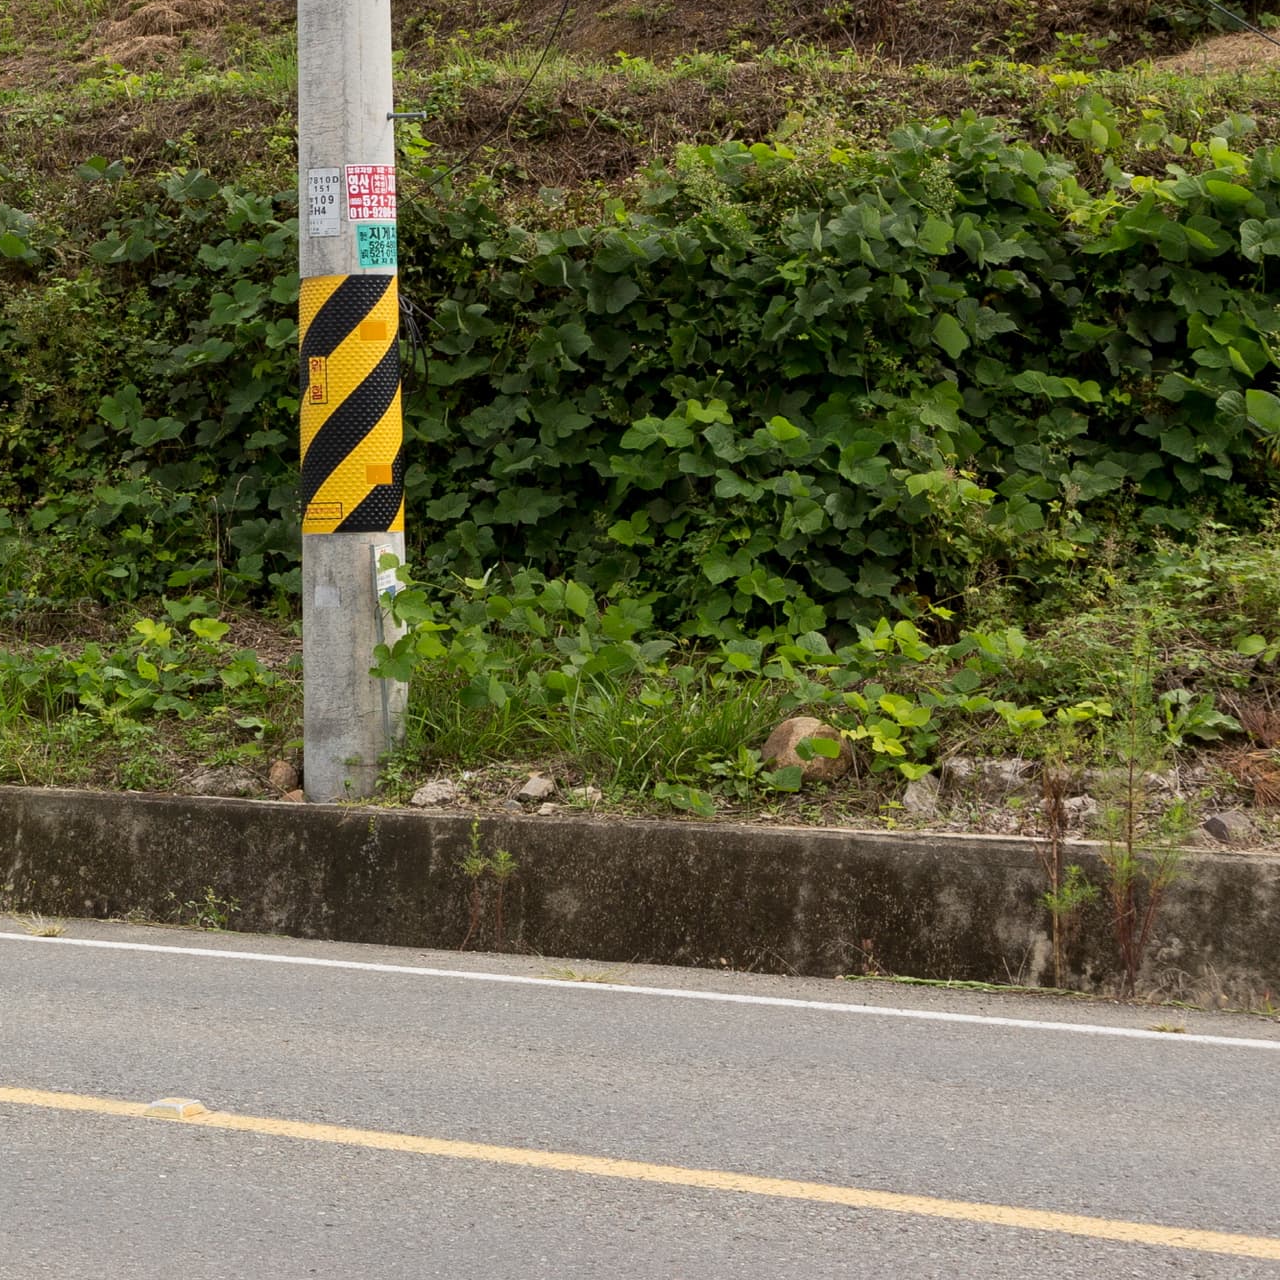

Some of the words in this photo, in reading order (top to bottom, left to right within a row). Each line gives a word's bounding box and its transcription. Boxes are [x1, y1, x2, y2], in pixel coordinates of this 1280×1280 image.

[348, 174, 370, 194] 영산
[314, 195, 335, 205] 109
[311, 359, 323, 401] 위험
